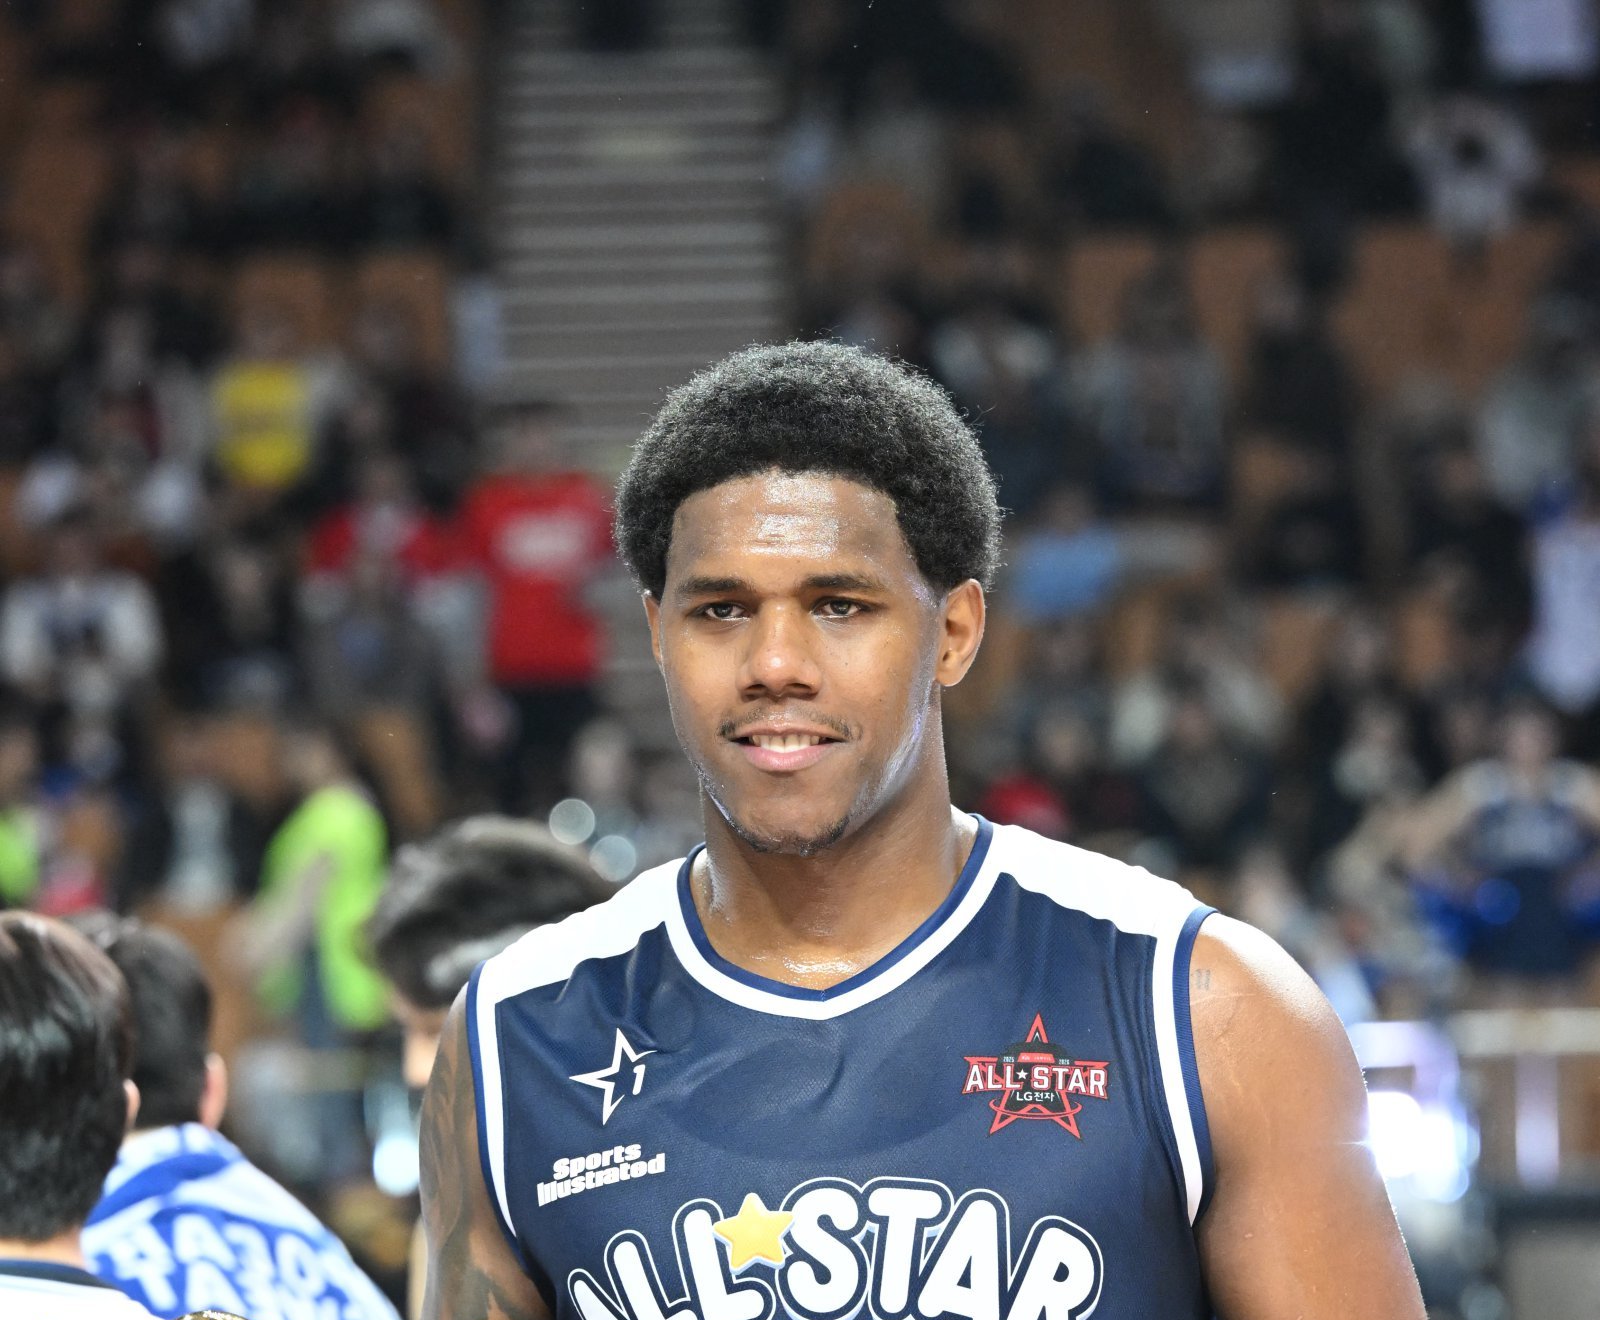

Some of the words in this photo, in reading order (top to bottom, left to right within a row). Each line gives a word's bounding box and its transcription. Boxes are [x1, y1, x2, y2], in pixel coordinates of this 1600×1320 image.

[632, 1063, 646, 1096] 1
[963, 1063, 1022, 1093] ALL
[1031, 1065, 1108, 1099] STAR
[1016, 1091, 1055, 1102] LG전자
[537, 1152, 666, 1207] Illustrated
[553, 1143, 642, 1181] Sports
